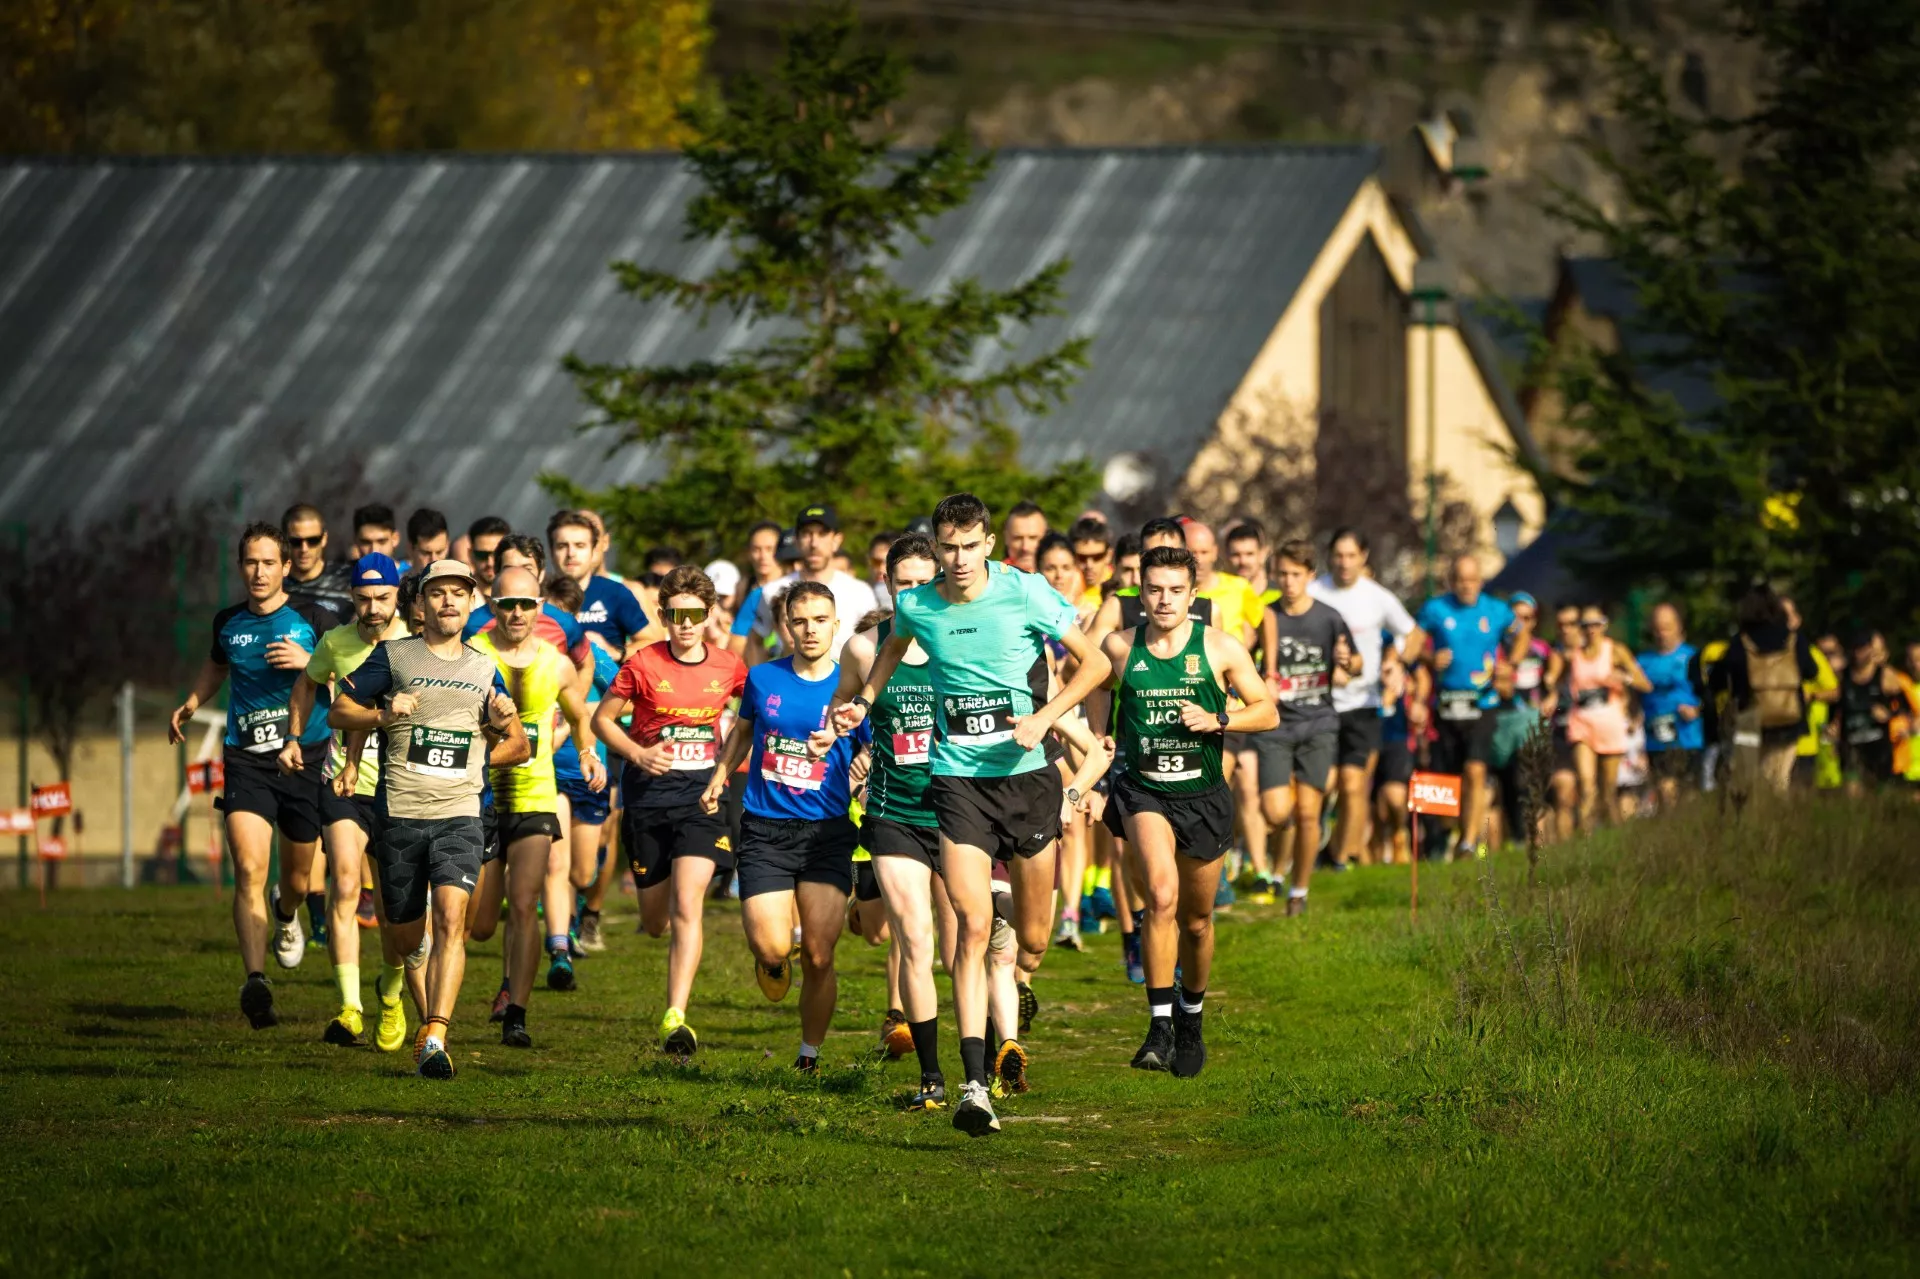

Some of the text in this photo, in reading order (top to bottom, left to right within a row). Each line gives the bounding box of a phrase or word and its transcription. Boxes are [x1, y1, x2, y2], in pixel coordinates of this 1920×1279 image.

[229, 634, 253, 647] utgs
[408, 677, 484, 694] DYNAFIT
[887, 685, 934, 693] FLORISTER
[908, 694, 935, 702] CISNE
[1136, 686, 1196, 698] FLORISTERÍA
[899, 703, 932, 713] JACA
[957, 696, 1010, 710] JUNCARAL
[1146, 700, 1156, 708] EL
[247, 708, 289, 724] JUNCARAL
[904, 718, 934, 728] JUNCA
[966, 714, 995, 734] 80
[253, 723, 279, 743] 82
[437, 730, 454, 738] Cross
[425, 734, 469, 745] JUNCARAL
[789, 740, 807, 748] Cross
[1152, 741, 1200, 750] JUNCARAL
[671, 743, 705, 761] 103
[777, 743, 808, 755] JUNCA
[427, 748, 454, 767] 65
[1157, 755, 1184, 772] 53
[775, 756, 812, 779] 156
